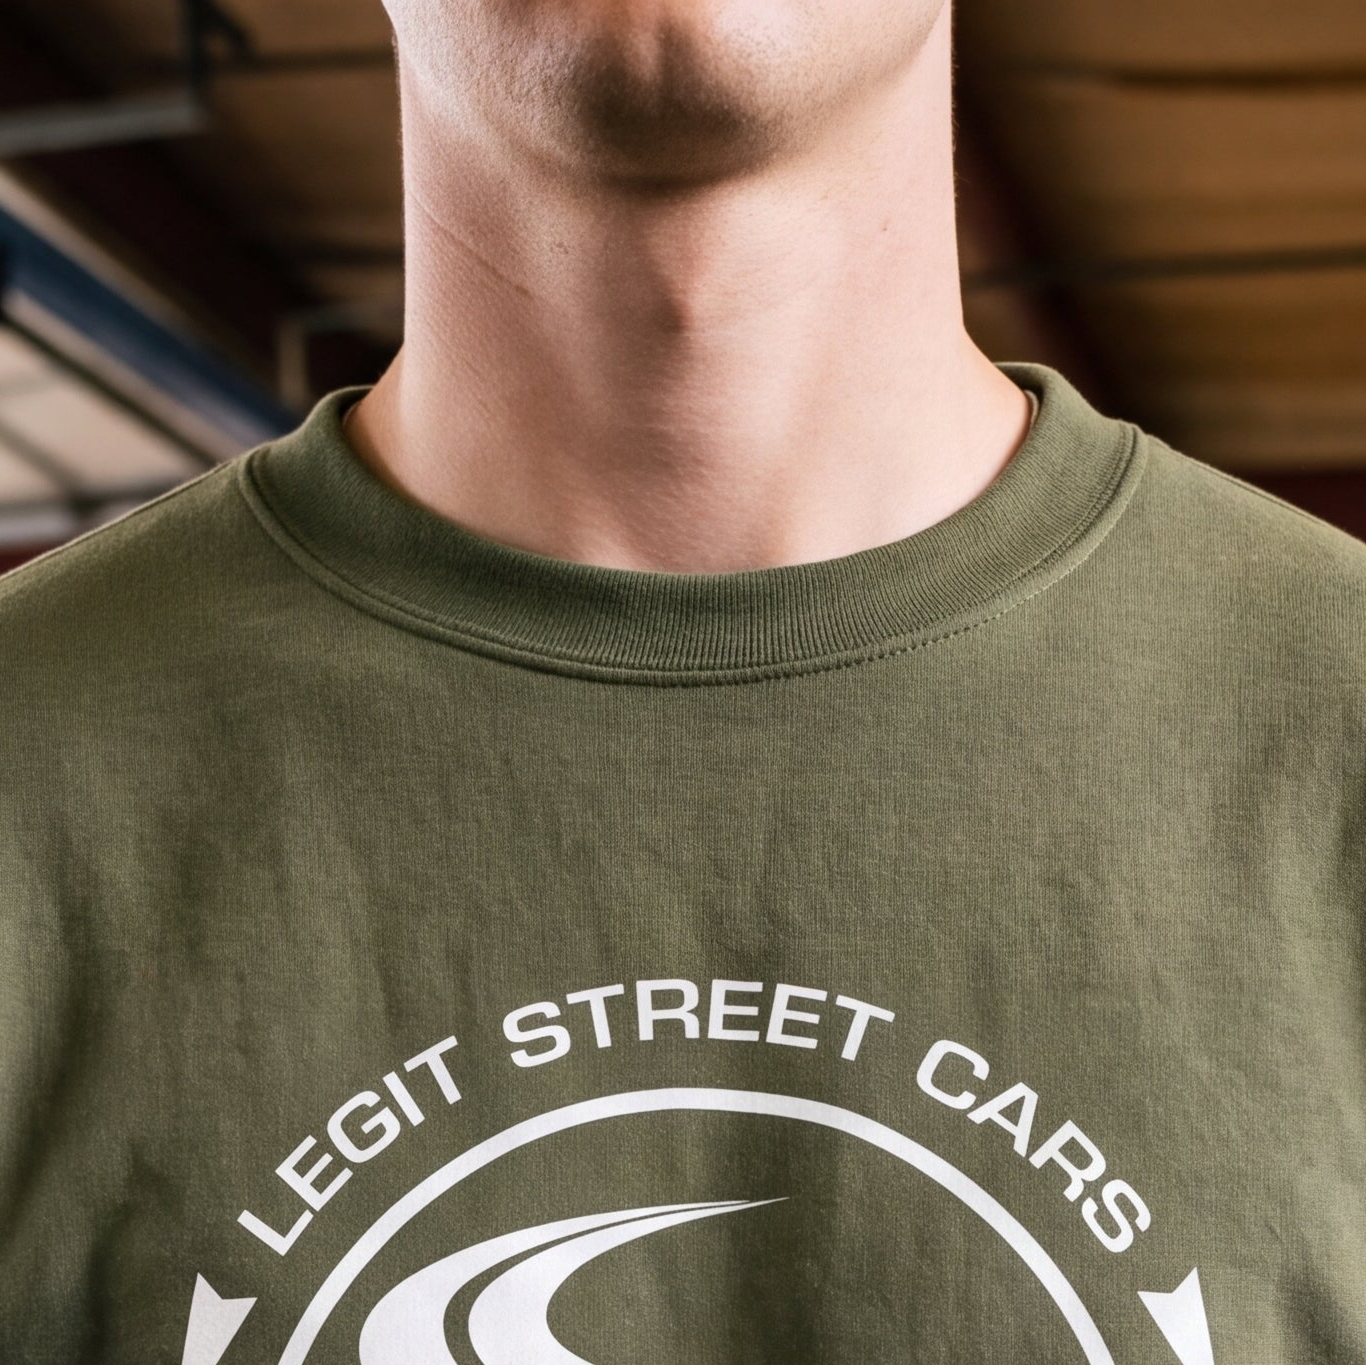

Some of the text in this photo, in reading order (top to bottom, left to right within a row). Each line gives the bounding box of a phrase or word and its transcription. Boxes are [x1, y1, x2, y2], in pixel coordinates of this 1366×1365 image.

[237, 978, 1152, 1256] LEGIT STREET CARS
